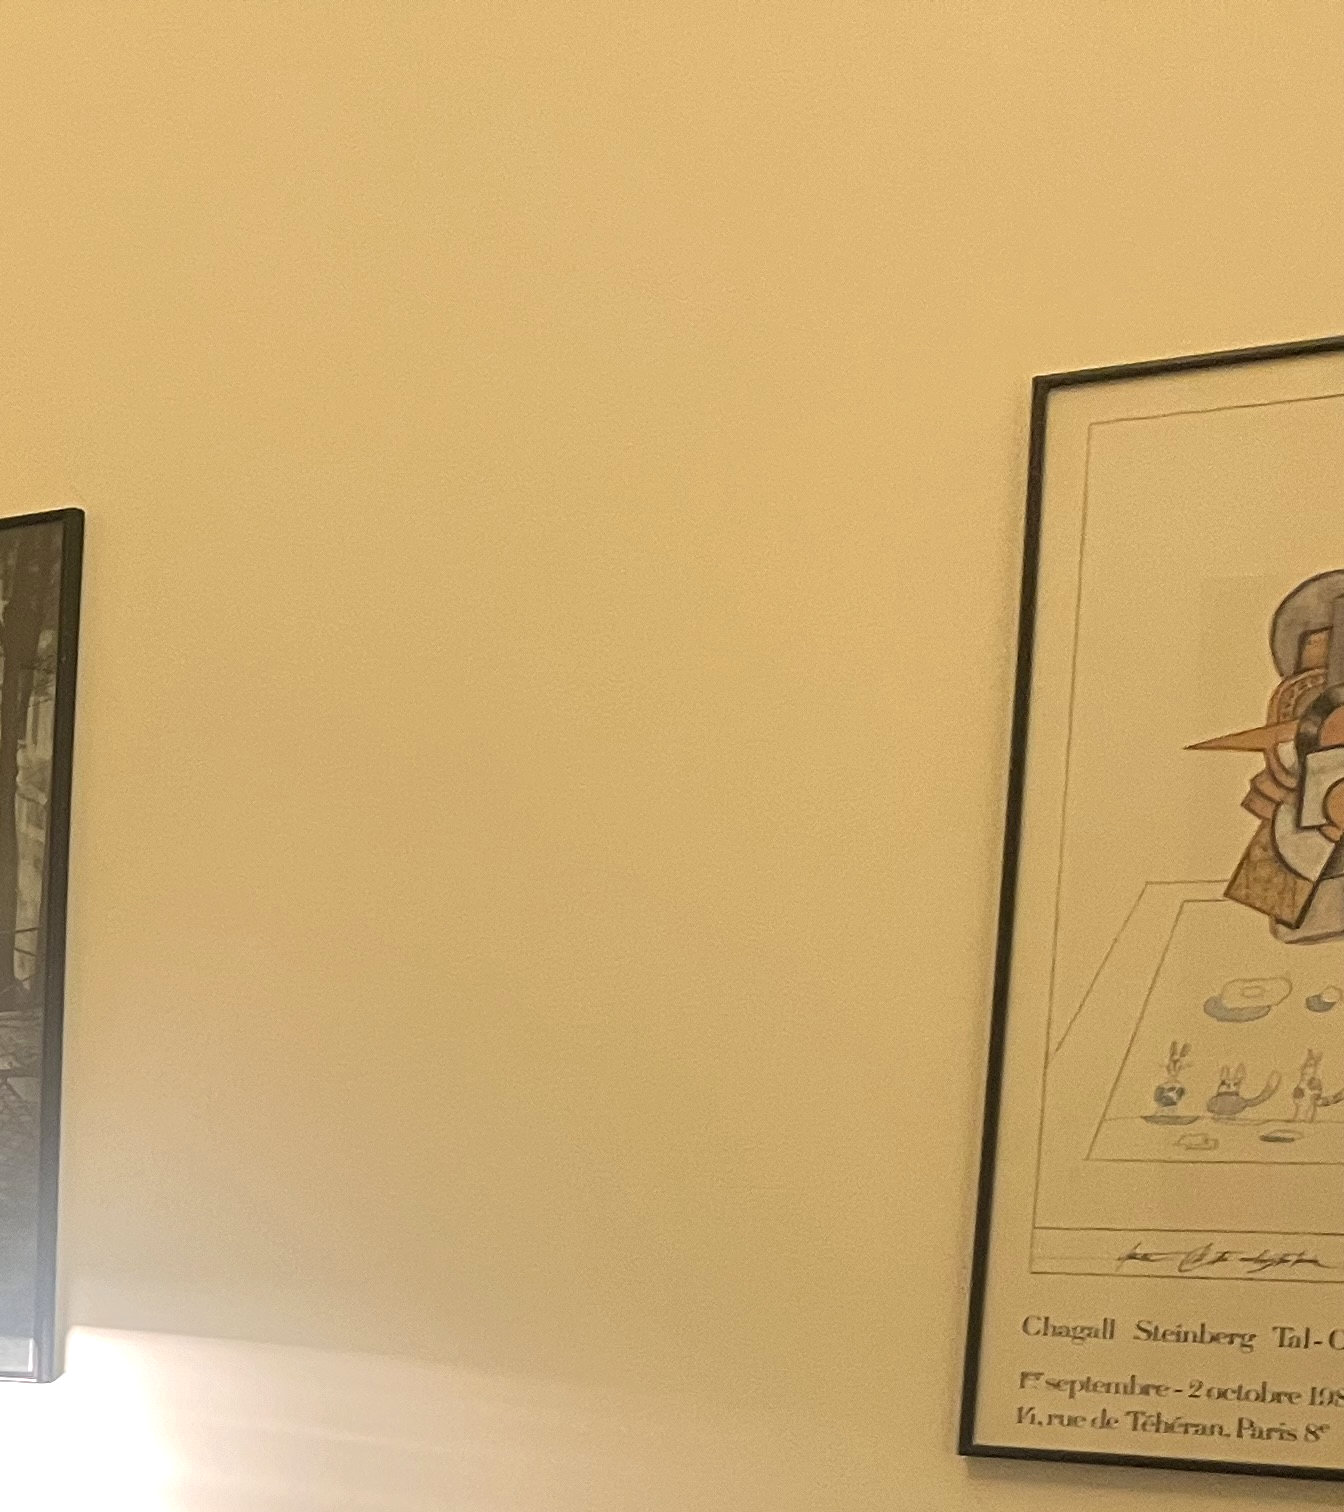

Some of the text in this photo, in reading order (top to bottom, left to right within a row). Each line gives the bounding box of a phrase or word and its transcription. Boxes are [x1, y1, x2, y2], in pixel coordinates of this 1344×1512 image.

[1022, 1314, 1116, 1345] Chagall
[1133, 1319, 1257, 1354] Steinberg
[1044, 1373, 1170, 1400] septembre
[1187, 1378, 1204, 1399] 2
[1206, 1381, 1303, 1405] octobre
[1046, 1413, 1087, 1428] rue
[1090, 1408, 1119, 1430] de
[1237, 1416, 1298, 1442] Paris
